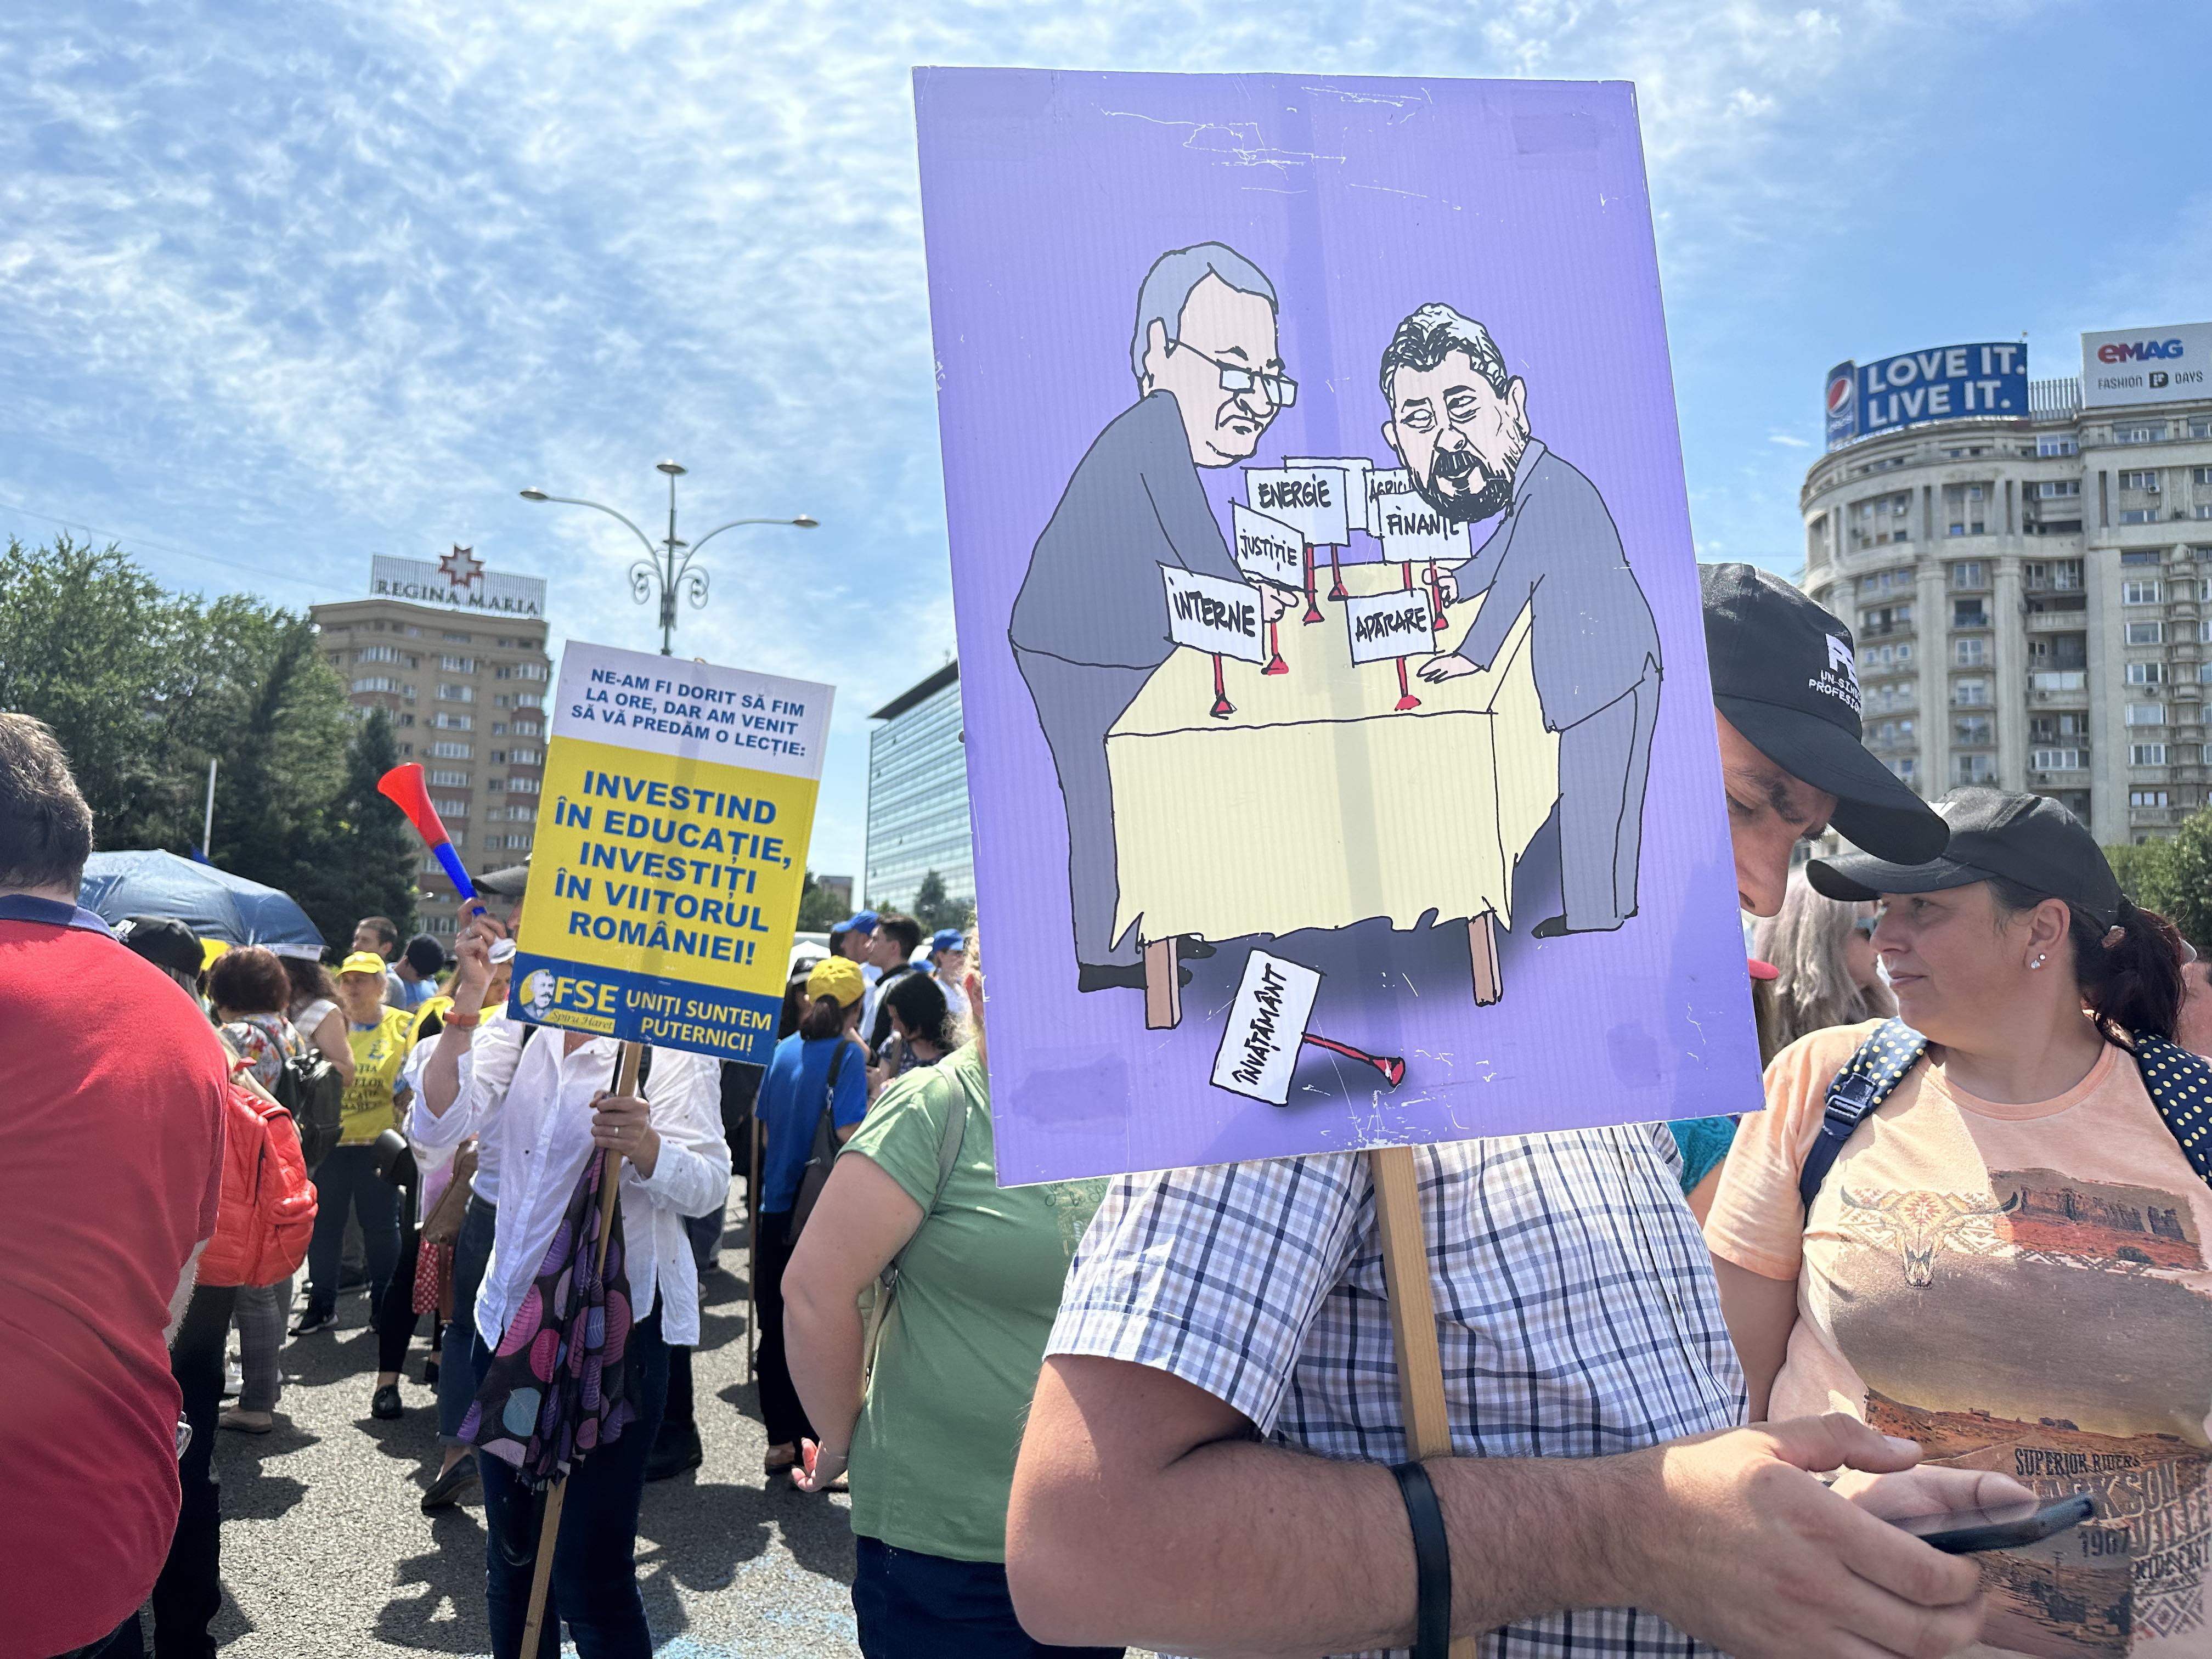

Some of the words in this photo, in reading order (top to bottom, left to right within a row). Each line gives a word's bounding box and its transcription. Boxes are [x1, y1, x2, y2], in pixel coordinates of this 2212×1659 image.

[1867, 348, 1968, 394] LOVE
[1981, 346, 2025, 375] IT.
[2098, 338, 2183, 363] eMAG
[2175, 370, 2203, 384] DAYS
[1868, 383, 1951, 428] LIVE
[1964, 380, 2011, 410] IT.
[1258, 473, 1331, 510] ENERGIE
[377, 580, 460, 604] REGINA
[469, 593, 538, 614] MARIA
[1169, 577, 1255, 637] INTERNE
[586, 688, 609, 703] LA
[615, 693, 657, 714] ORE,
[664, 701, 702, 719] DAR
[707, 710, 736, 725] AM
[742, 714, 798, 735] VENIT
[591, 669, 650, 691] NE-AM
[656, 680, 672, 694] FI
[678, 684, 736, 704] DORIT
[741, 694, 766, 710] SĂ
[772, 700, 805, 717] FIM
[571, 704, 596, 721] SĂ
[602, 709, 627, 726] VĂ
[633, 715, 710, 740] PREDĂM
[716, 730, 729, 743] O
[735, 733, 806, 757] LECȚIE:
[583, 770, 776, 825] INVESTIND
[555, 795, 592, 830] ÎN
[604, 809, 792, 870] EDUCAȚIE,
[580, 841, 757, 899] INVESTIȚI
[555, 867, 591, 901] ÎN
[605, 881, 769, 932] VIITORUL
[568, 910, 756, 966] ROMÂNIEI!
[554, 976, 619, 1013] FSE
[626, 989, 681, 1017] UNIȚI
[686, 1000, 772, 1031] SUNTEM
[551, 1010, 579, 1024] Spiru
[580, 1015, 613, 1030] Haret
[641, 1017, 754, 1052] PUTERNICI!
[2015, 1448, 2087, 1478] SUPERIOR
[2092, 1453, 2141, 1472] RIDERS
